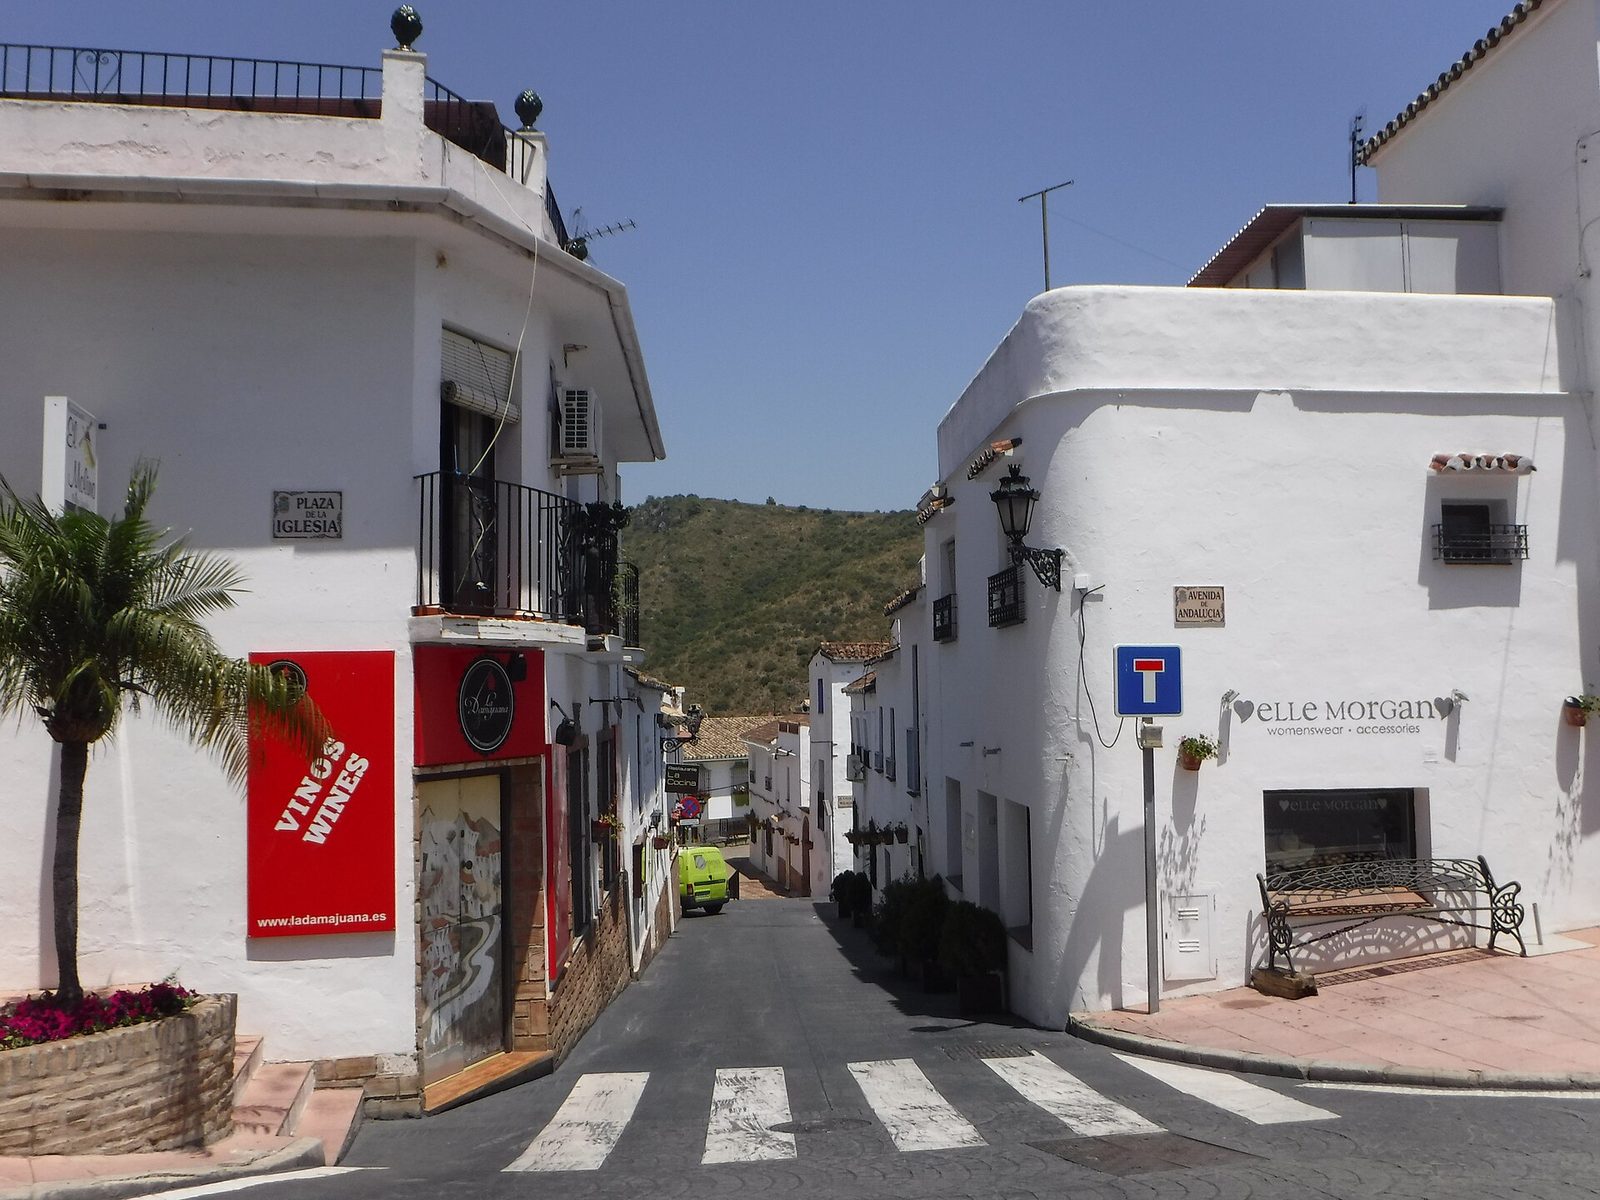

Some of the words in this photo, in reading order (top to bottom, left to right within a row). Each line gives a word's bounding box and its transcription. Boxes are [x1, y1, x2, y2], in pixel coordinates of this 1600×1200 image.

[297, 498, 334, 509] PLAZA
[277, 520, 338, 533] IGLESIA
[1188, 591, 1221, 600] AVENIDA
[1178, 609, 1221, 618] ANDALUCIA
[1267, 726, 1343, 736] womenswear
[1356, 723, 1420, 735] accessories
[274, 737, 345, 831] VINOS
[302, 753, 369, 844] WINES
[257, 912, 387, 927] www.ladamajuana.es
